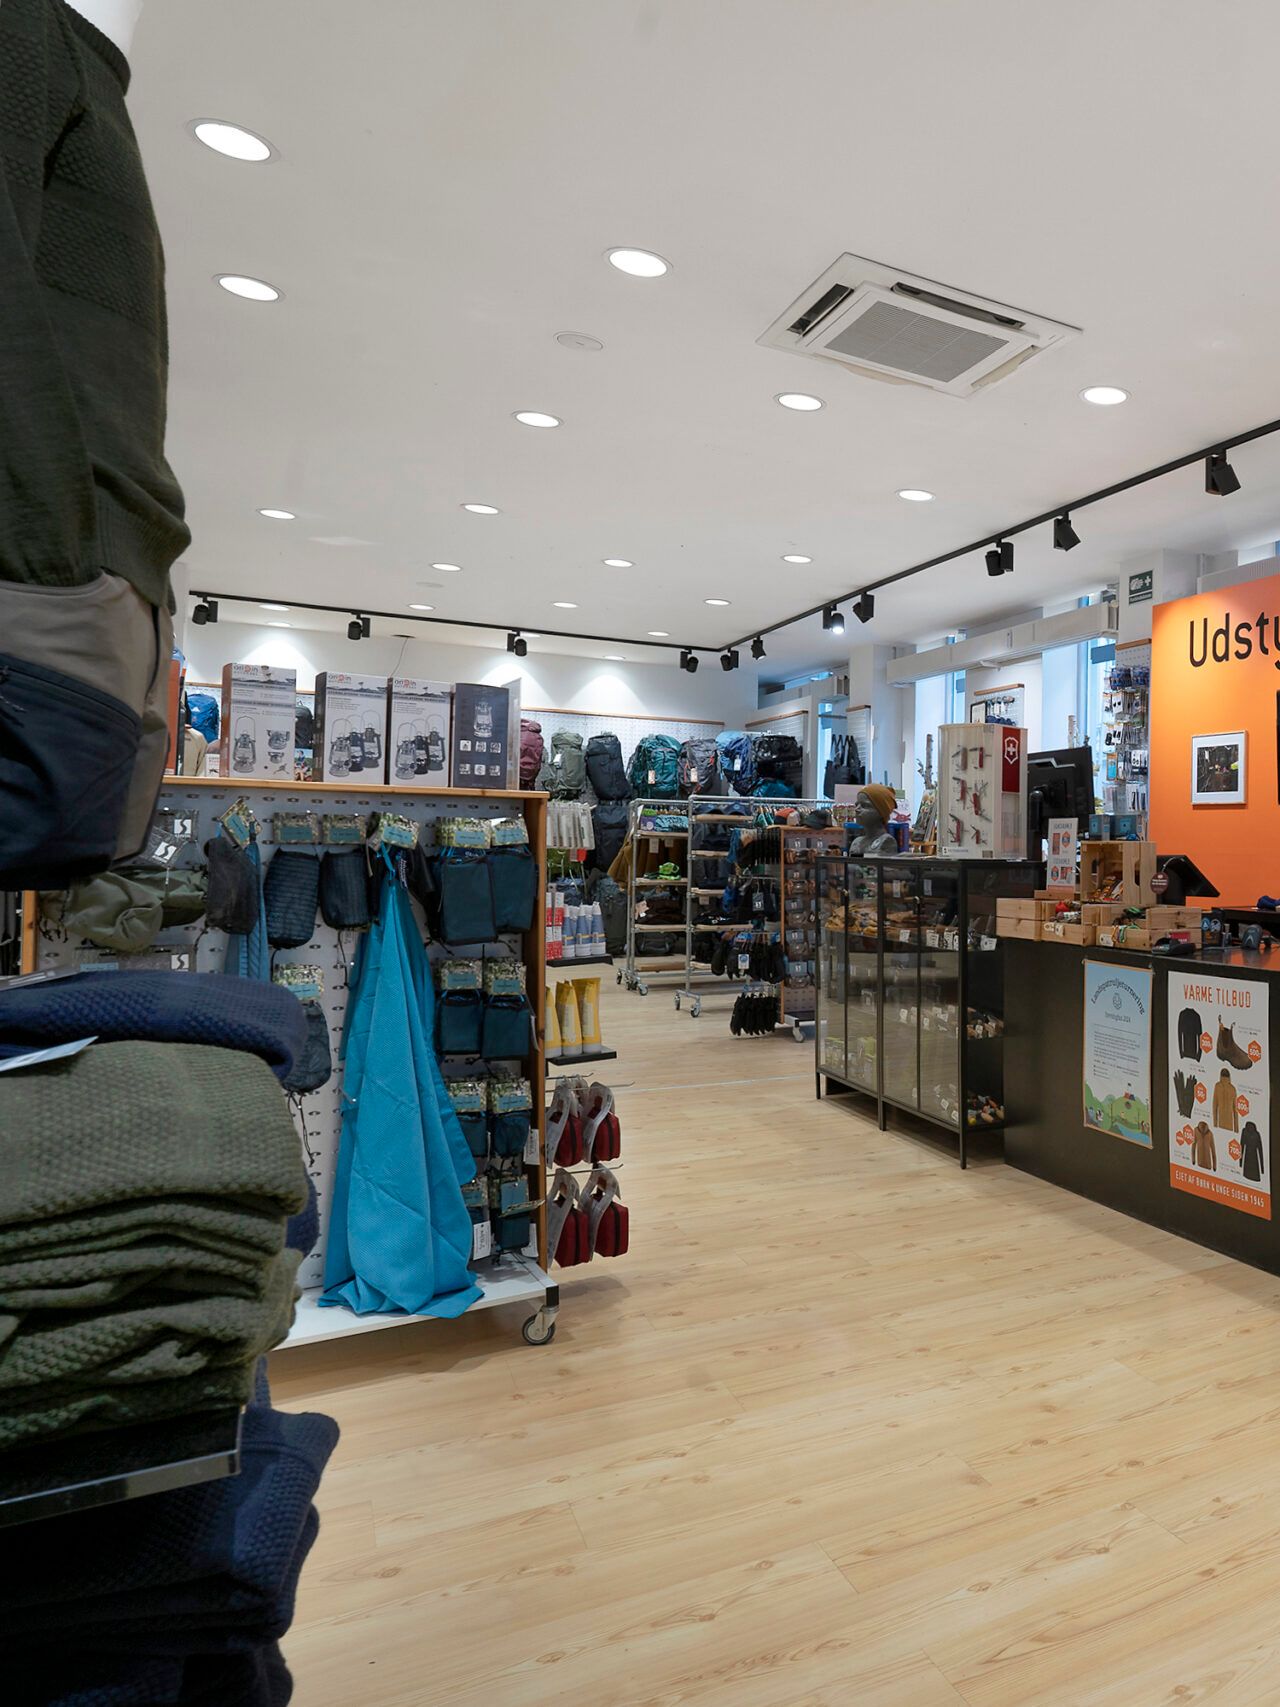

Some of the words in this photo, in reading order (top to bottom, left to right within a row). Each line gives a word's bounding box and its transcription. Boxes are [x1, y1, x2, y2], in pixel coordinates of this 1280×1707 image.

[1183, 984, 1213, 1003] VARME
[1216, 988, 1251, 1008] TILBUD
[1250, 1194, 1264, 1208] 1945
